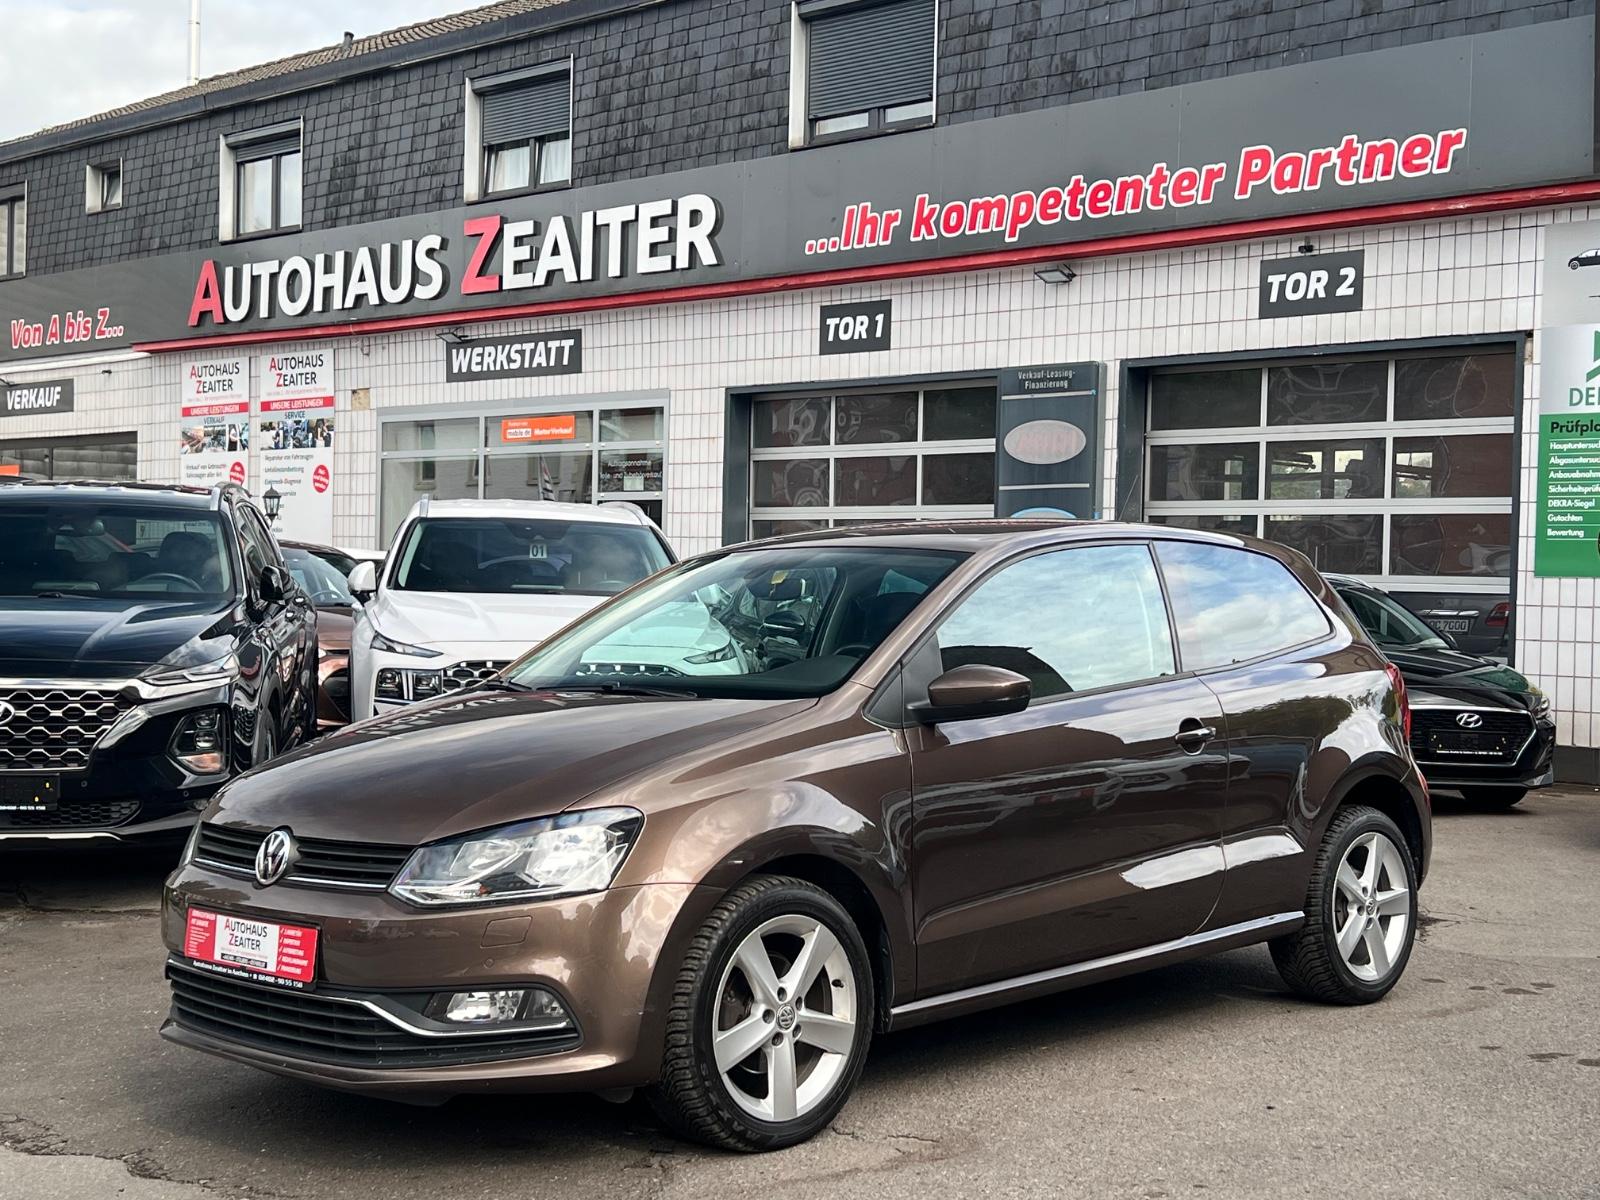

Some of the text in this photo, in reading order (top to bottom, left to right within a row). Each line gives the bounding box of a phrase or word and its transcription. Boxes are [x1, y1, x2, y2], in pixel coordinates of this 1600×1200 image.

[805, 127, 1467, 256] ...Ihr kompetenter Partner
[188, 193, 718, 327] AUTOHAUS ZEAITER
[1267, 267, 1357, 303] TOR 2
[11, 307, 124, 349] Von A bis Z...
[826, 313, 884, 342] TOR 1
[269, 353, 324, 372] AUTOHAUS
[452, 339, 575, 374] WERKSTATT
[190, 361, 240, 379] AUTOHAUS
[276, 371, 317, 387] ZEAITER
[196, 379, 234, 394] ZEAITER
[1025, 380, 1068, 389] Finanzierung
[7, 386, 61, 410] VERKAUF
[1569, 387, 1600, 406] DE
[284, 411, 305, 419] SERVICE
[1548, 499, 1595, 509] DEKRA-Siegel
[1548, 514, 1583, 522] Gutachten
[1547, 529, 1584, 538] Bewertung
[531, 545, 544, 557] 01
[225, 918, 268, 938] AUTOHAUS
[229, 933, 261, 951] ZEAITER
